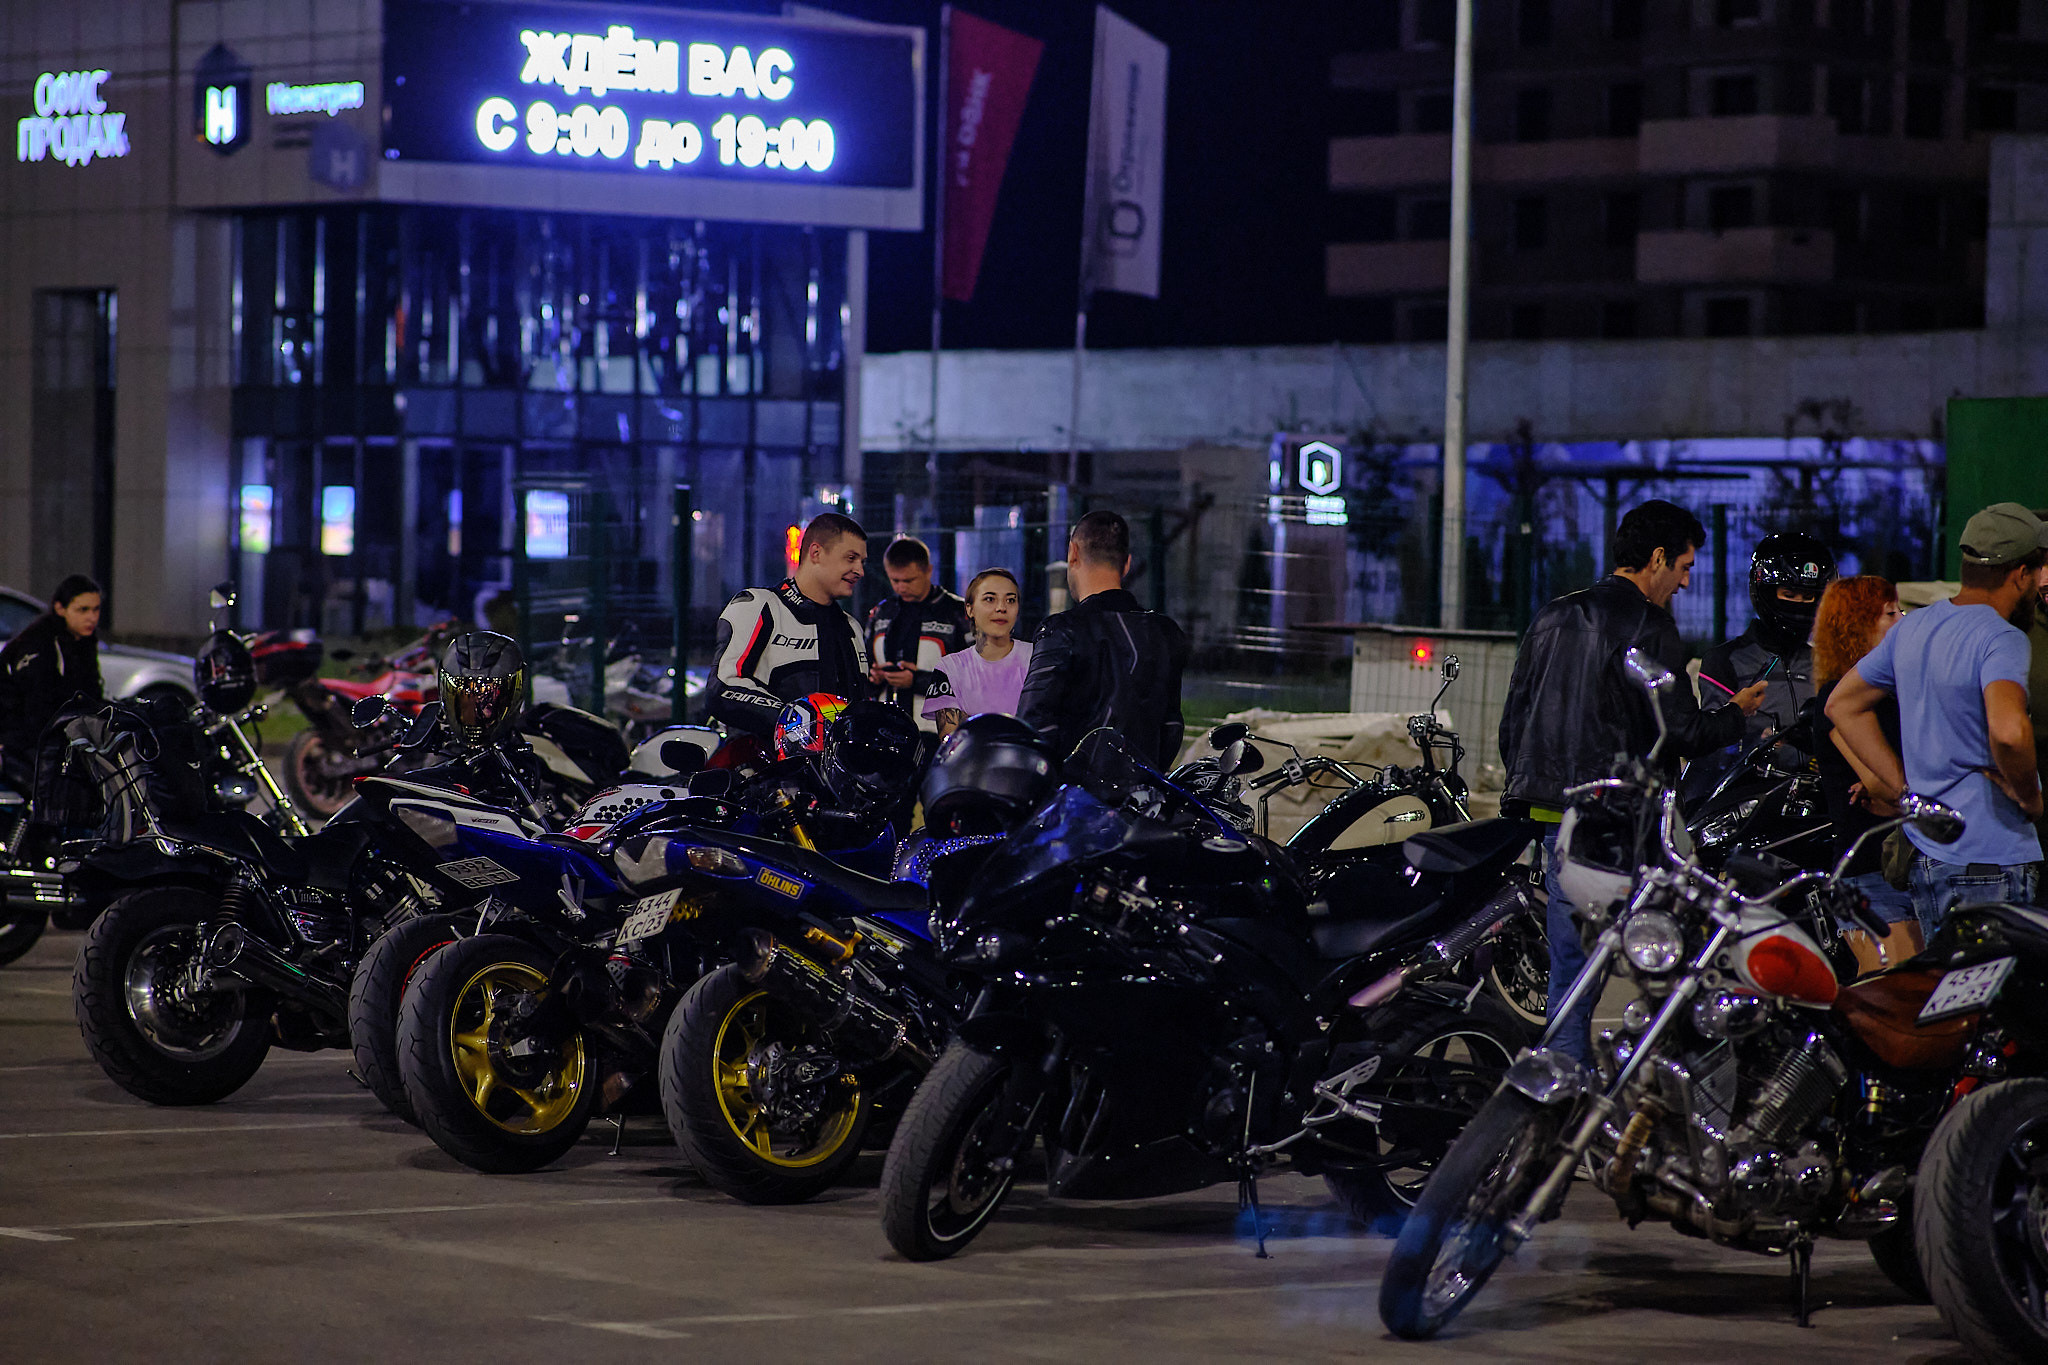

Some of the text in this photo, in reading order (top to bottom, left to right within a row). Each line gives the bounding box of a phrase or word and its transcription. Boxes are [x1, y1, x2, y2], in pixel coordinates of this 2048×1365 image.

[519, 24, 795, 101] ЖДЁМ ВАС
[34, 69, 110, 117] ОФИС
[16, 111, 129, 167] ПРОДАЖ
[476, 96, 836, 172] С 9:00 до 19:00
[720, 690, 784, 709] DAINESE
[759, 870, 801, 897] ÖHLINS
[635, 893, 673, 915] 6344
[644, 916, 664, 933] 23
[1948, 963, 2000, 986] 4571
[1961, 986, 1989, 1004] 23
